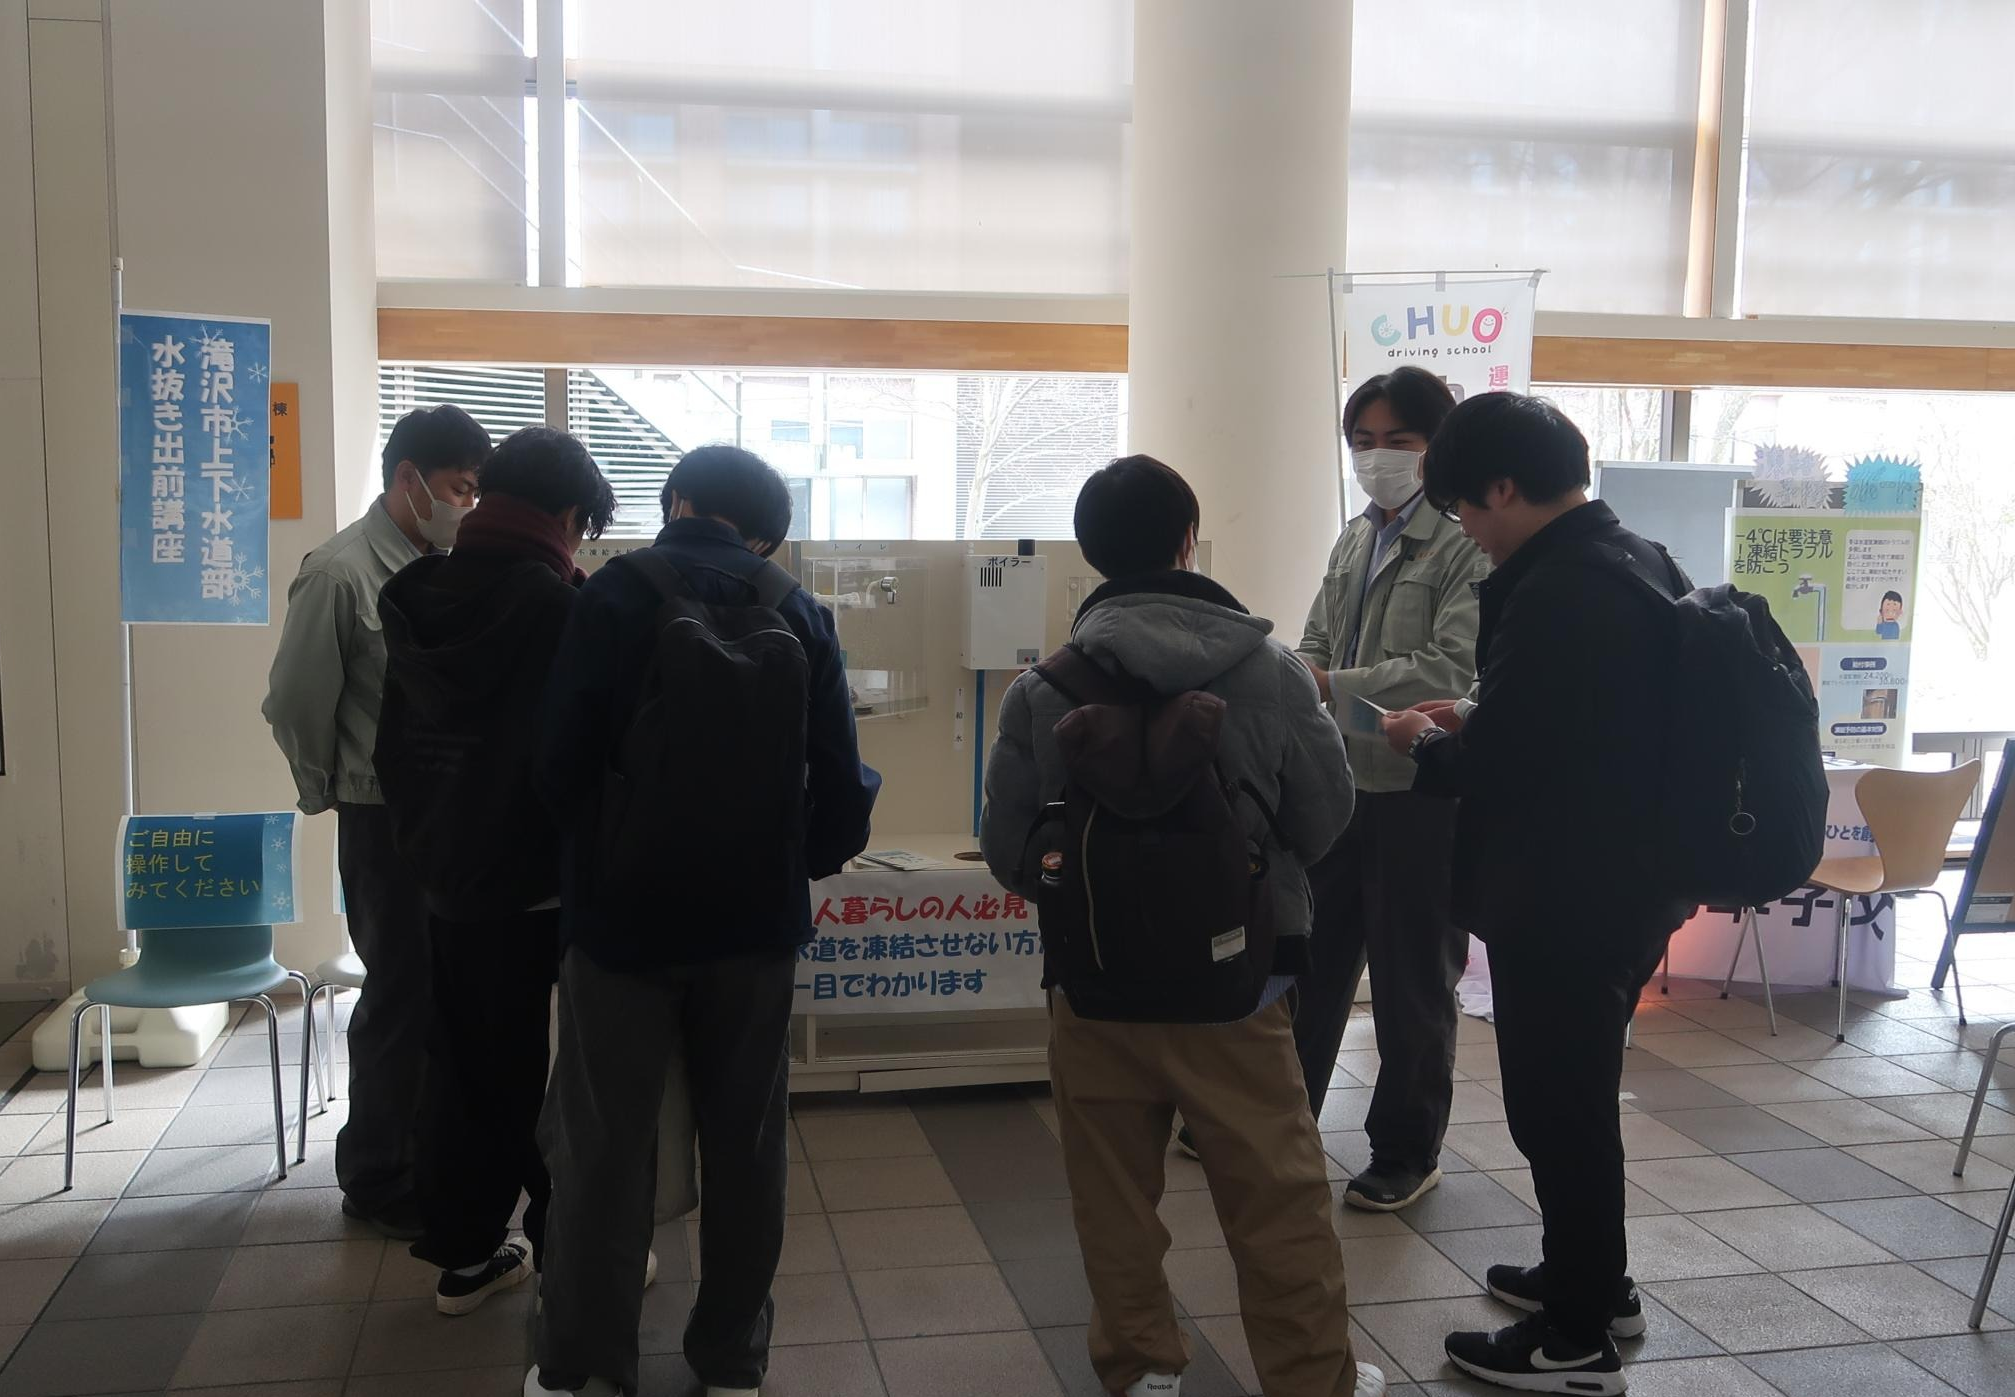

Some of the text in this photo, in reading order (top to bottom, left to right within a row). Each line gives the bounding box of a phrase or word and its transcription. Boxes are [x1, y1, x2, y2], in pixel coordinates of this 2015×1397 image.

[1371, 304, 1503, 346] CHUO
[1388, 344, 1492, 358] driving school
[1489, 364, 1509, 393] 運
[152, 335, 186, 564] 水抜き出前講座
[201, 338, 235, 600] 滝沢市上下水道部
[833, 542, 887, 552] トイレ
[988, 556, 1032, 568] ボイラー
[129, 828, 215, 848] ご自由に
[126, 853, 214, 875] 操作して
[126, 878, 260, 900] みてください
[813, 893, 1028, 926] 人暮らしの人必見
[796, 930, 1043, 962] 道を凍結させない方
[794, 969, 988, 1000] 一目でわかります
